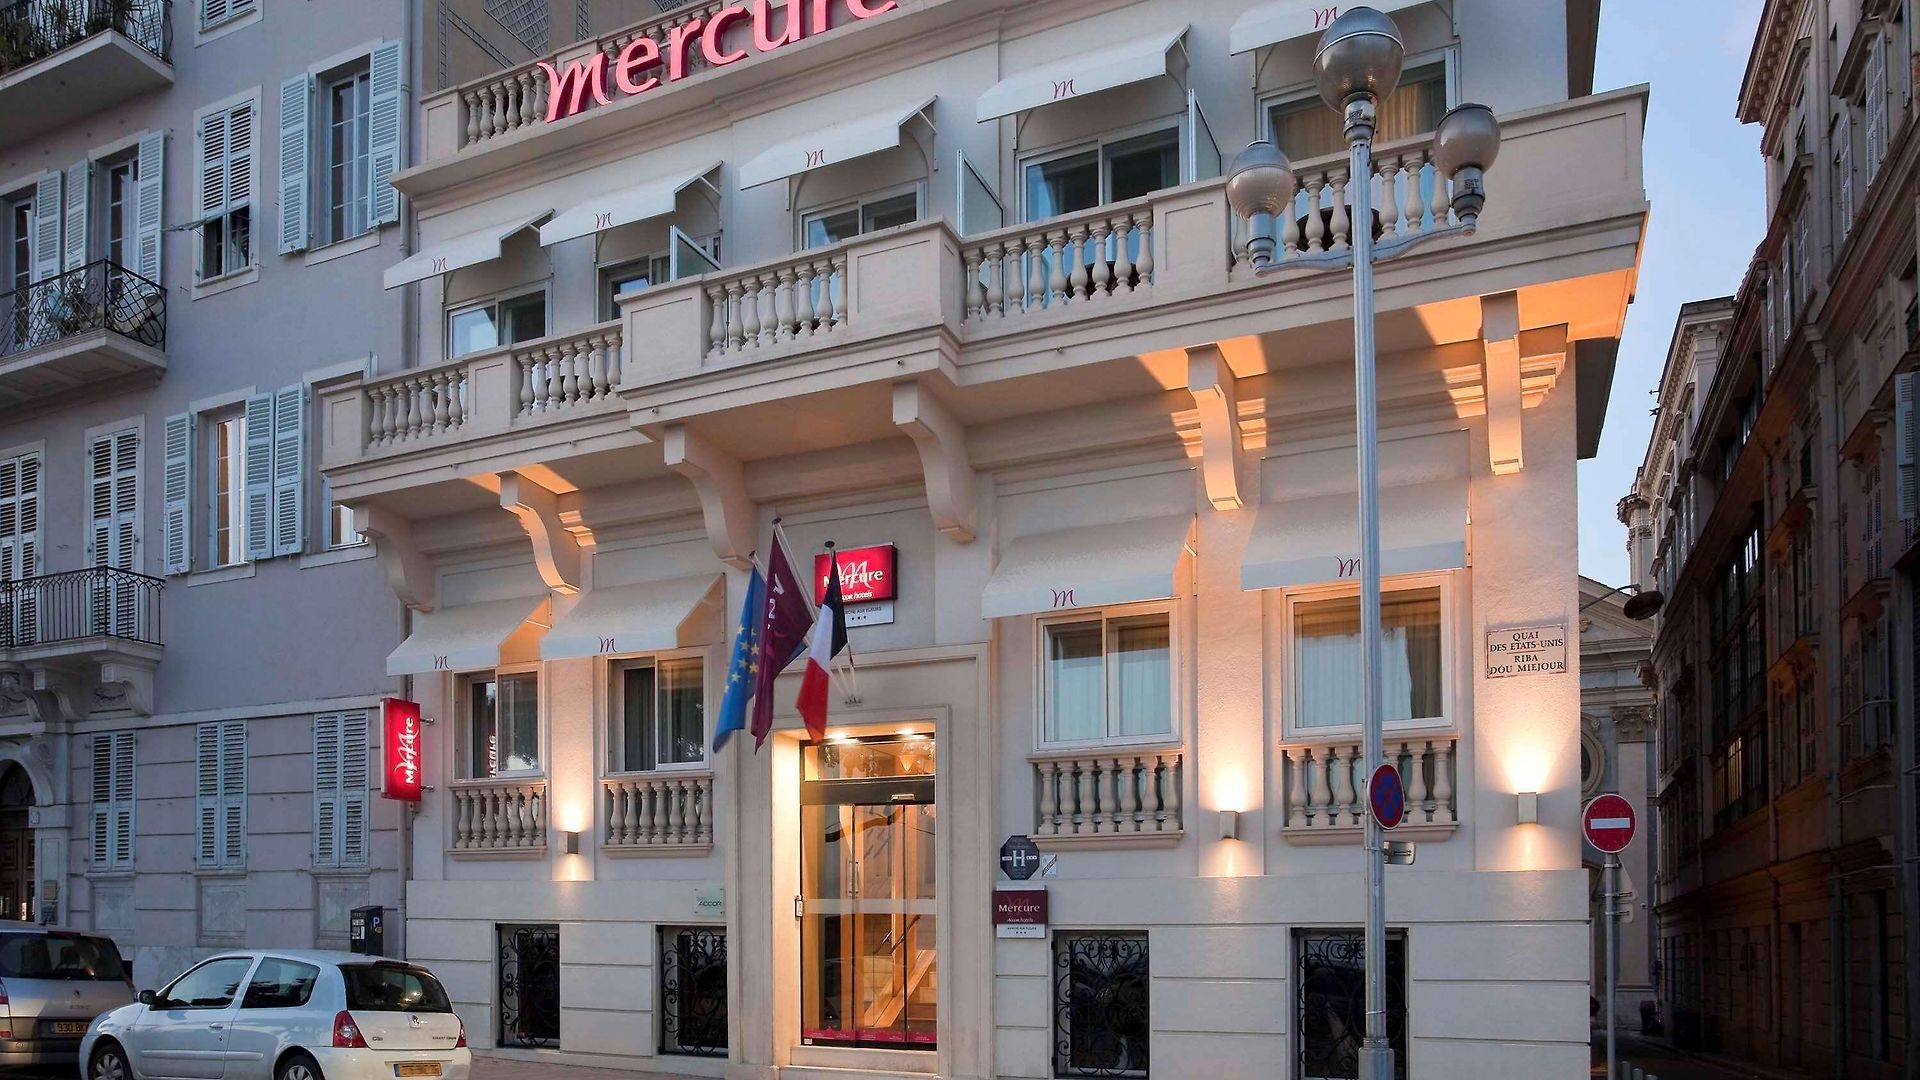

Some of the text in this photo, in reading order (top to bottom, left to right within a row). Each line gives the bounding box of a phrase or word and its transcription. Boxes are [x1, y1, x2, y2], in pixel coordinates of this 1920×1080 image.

[1512, 631, 1539, 641] QUAI
[1489, 639, 1564, 652] DES ETATS-UNIS
[1514, 654, 1538, 663] RIBA
[1517, 661, 1565, 671] MIEJOUR
[1012, 850, 1026, 868] H
[998, 904, 1040, 913] Mercure
